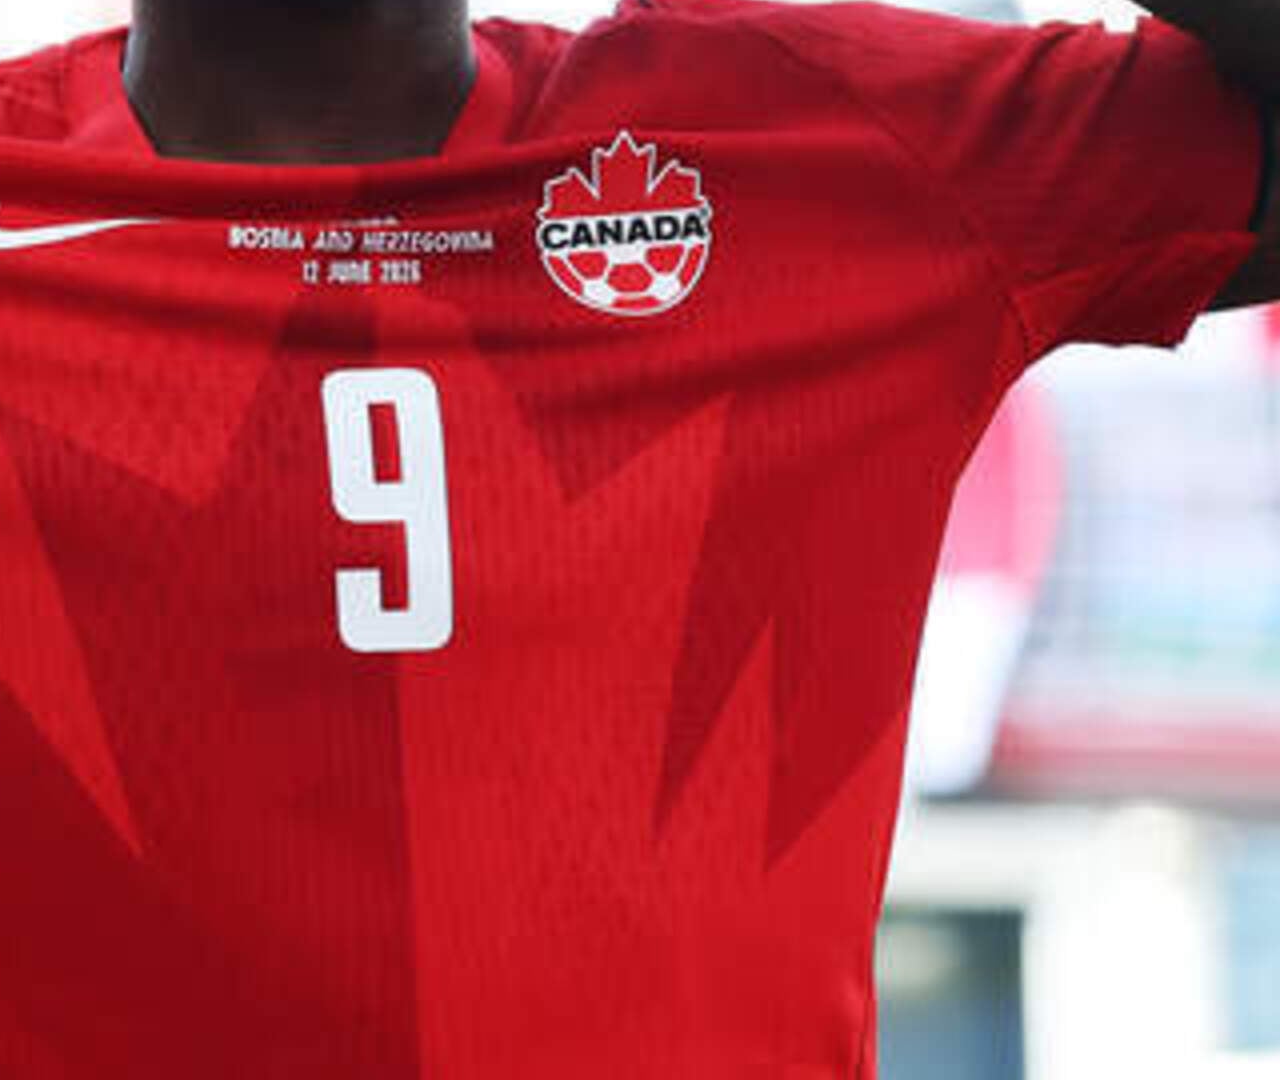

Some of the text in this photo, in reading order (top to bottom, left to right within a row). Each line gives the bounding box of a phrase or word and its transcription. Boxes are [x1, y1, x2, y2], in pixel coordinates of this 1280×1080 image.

[228, 225, 494, 253] BOSNIA AND HERZEGOVINA
[541, 214, 706, 250] CANADA
[302, 260, 319, 283] 12
[328, 260, 371, 284] JUNE
[322, 368, 454, 652] 9
